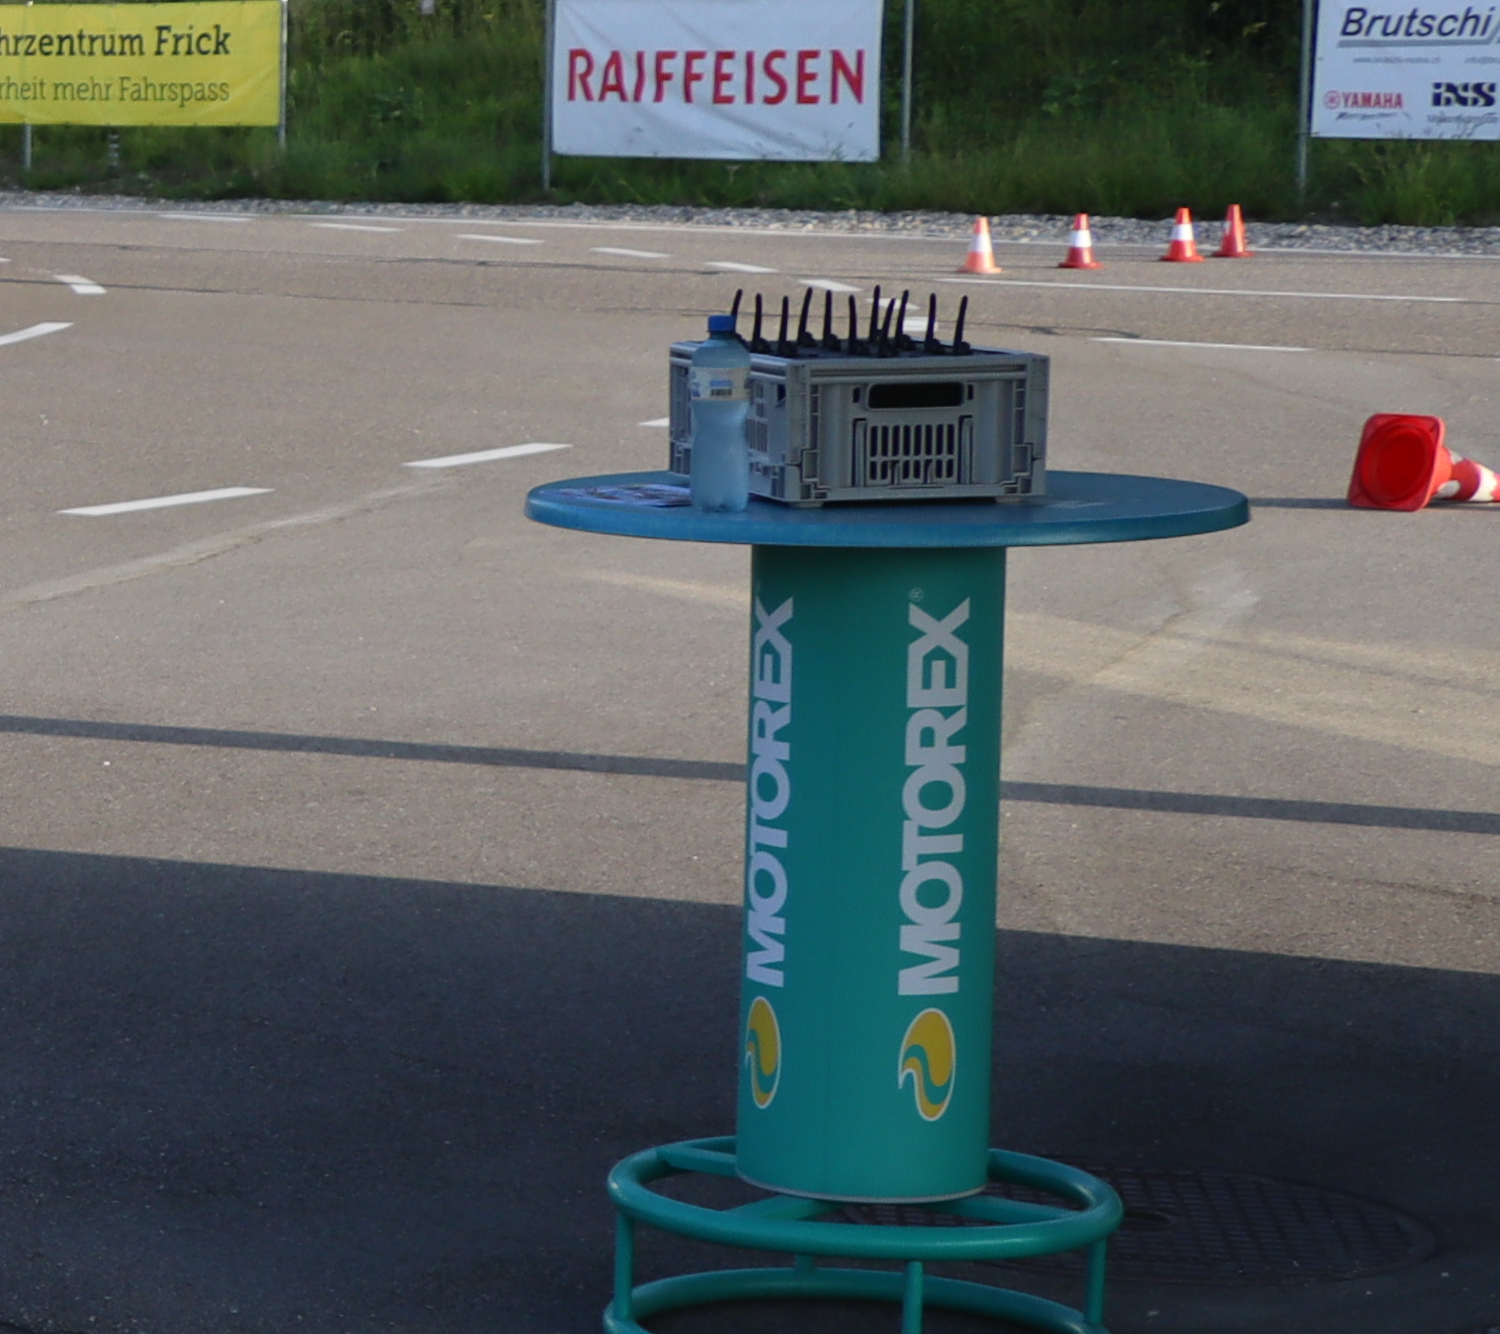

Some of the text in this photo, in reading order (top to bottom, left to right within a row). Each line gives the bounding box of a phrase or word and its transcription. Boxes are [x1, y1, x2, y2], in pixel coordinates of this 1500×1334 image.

[1340, 5, 1496, 37] Brutschi
[154, 24, 232, 57] Frick
[53, 76, 112, 101] mehr
[118, 76, 231, 108] Fahrspass
[567, 48, 866, 105] RAIFFEISEN
[1342, 92, 1404, 109] YAMAHA
[746, 596, 794, 988] MOTOREX
